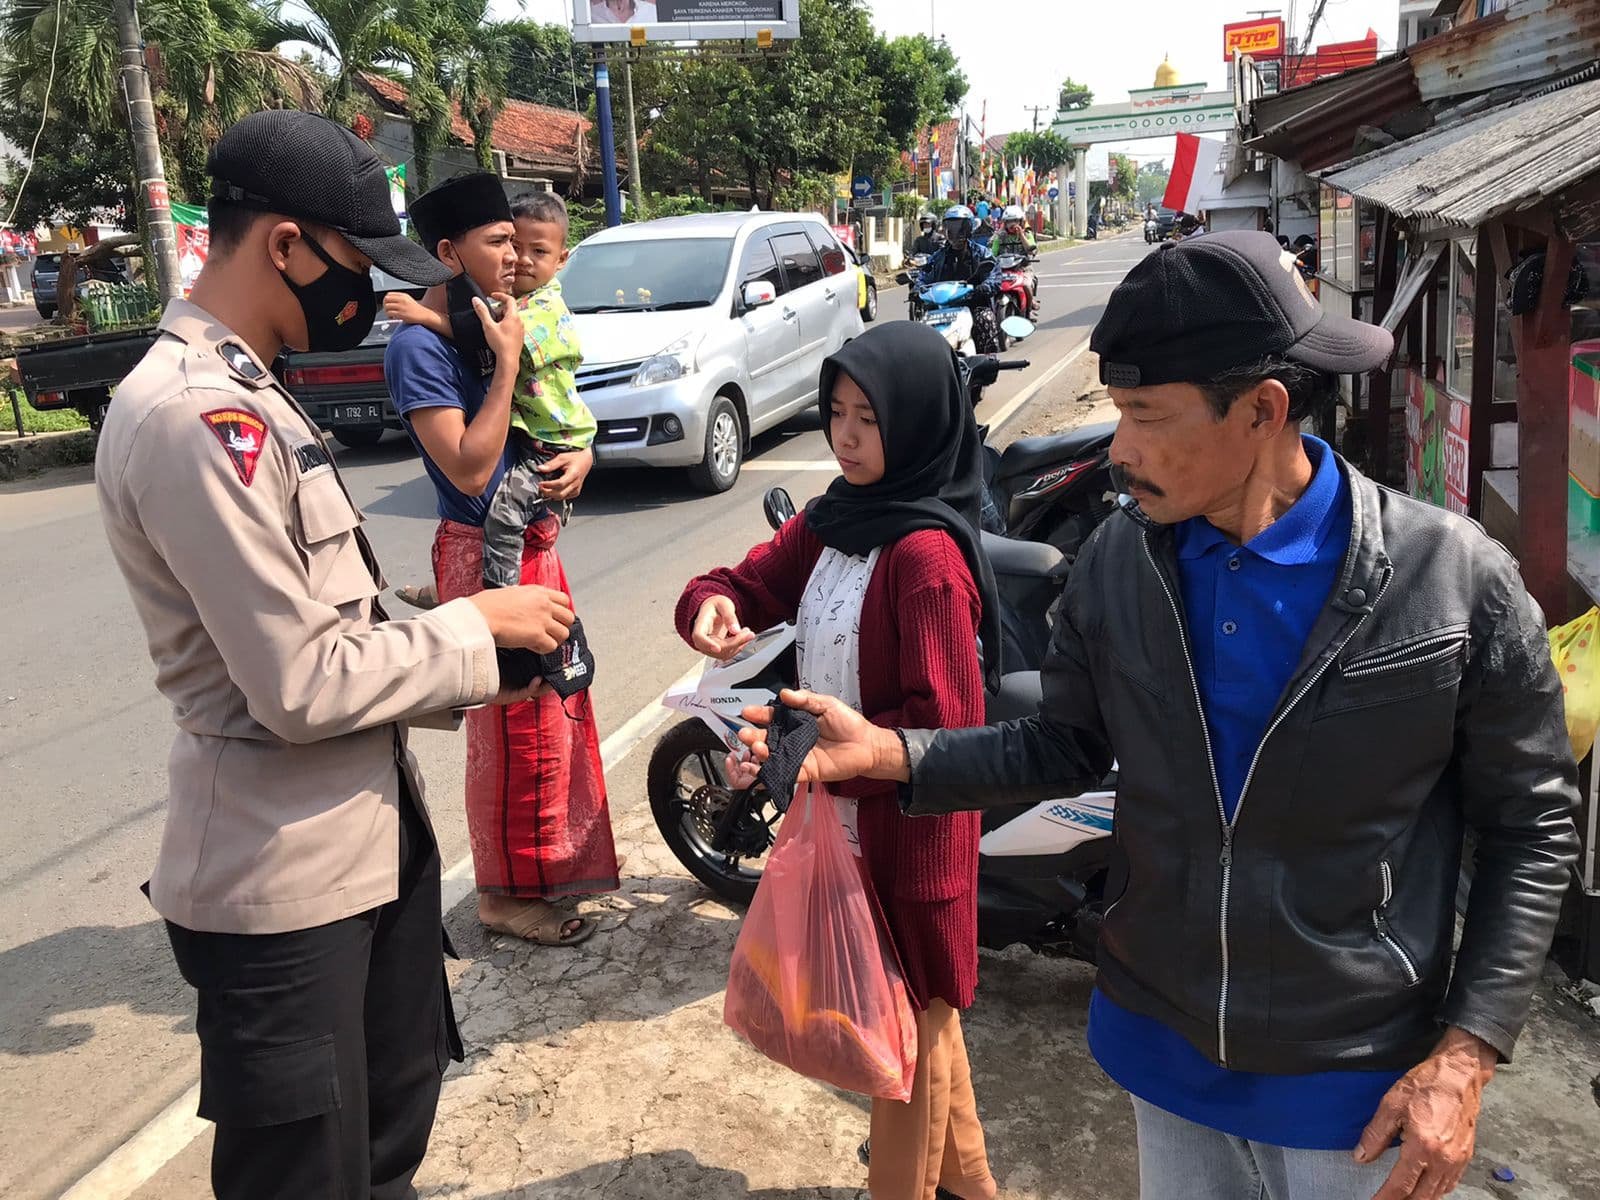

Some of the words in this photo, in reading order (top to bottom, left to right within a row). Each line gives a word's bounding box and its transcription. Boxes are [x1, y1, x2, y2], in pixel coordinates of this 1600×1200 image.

[334, 407, 340, 418] A
[346, 406, 362, 418] 1792
[368, 405, 379, 417] FL
[710, 696, 742, 704] HONDA
